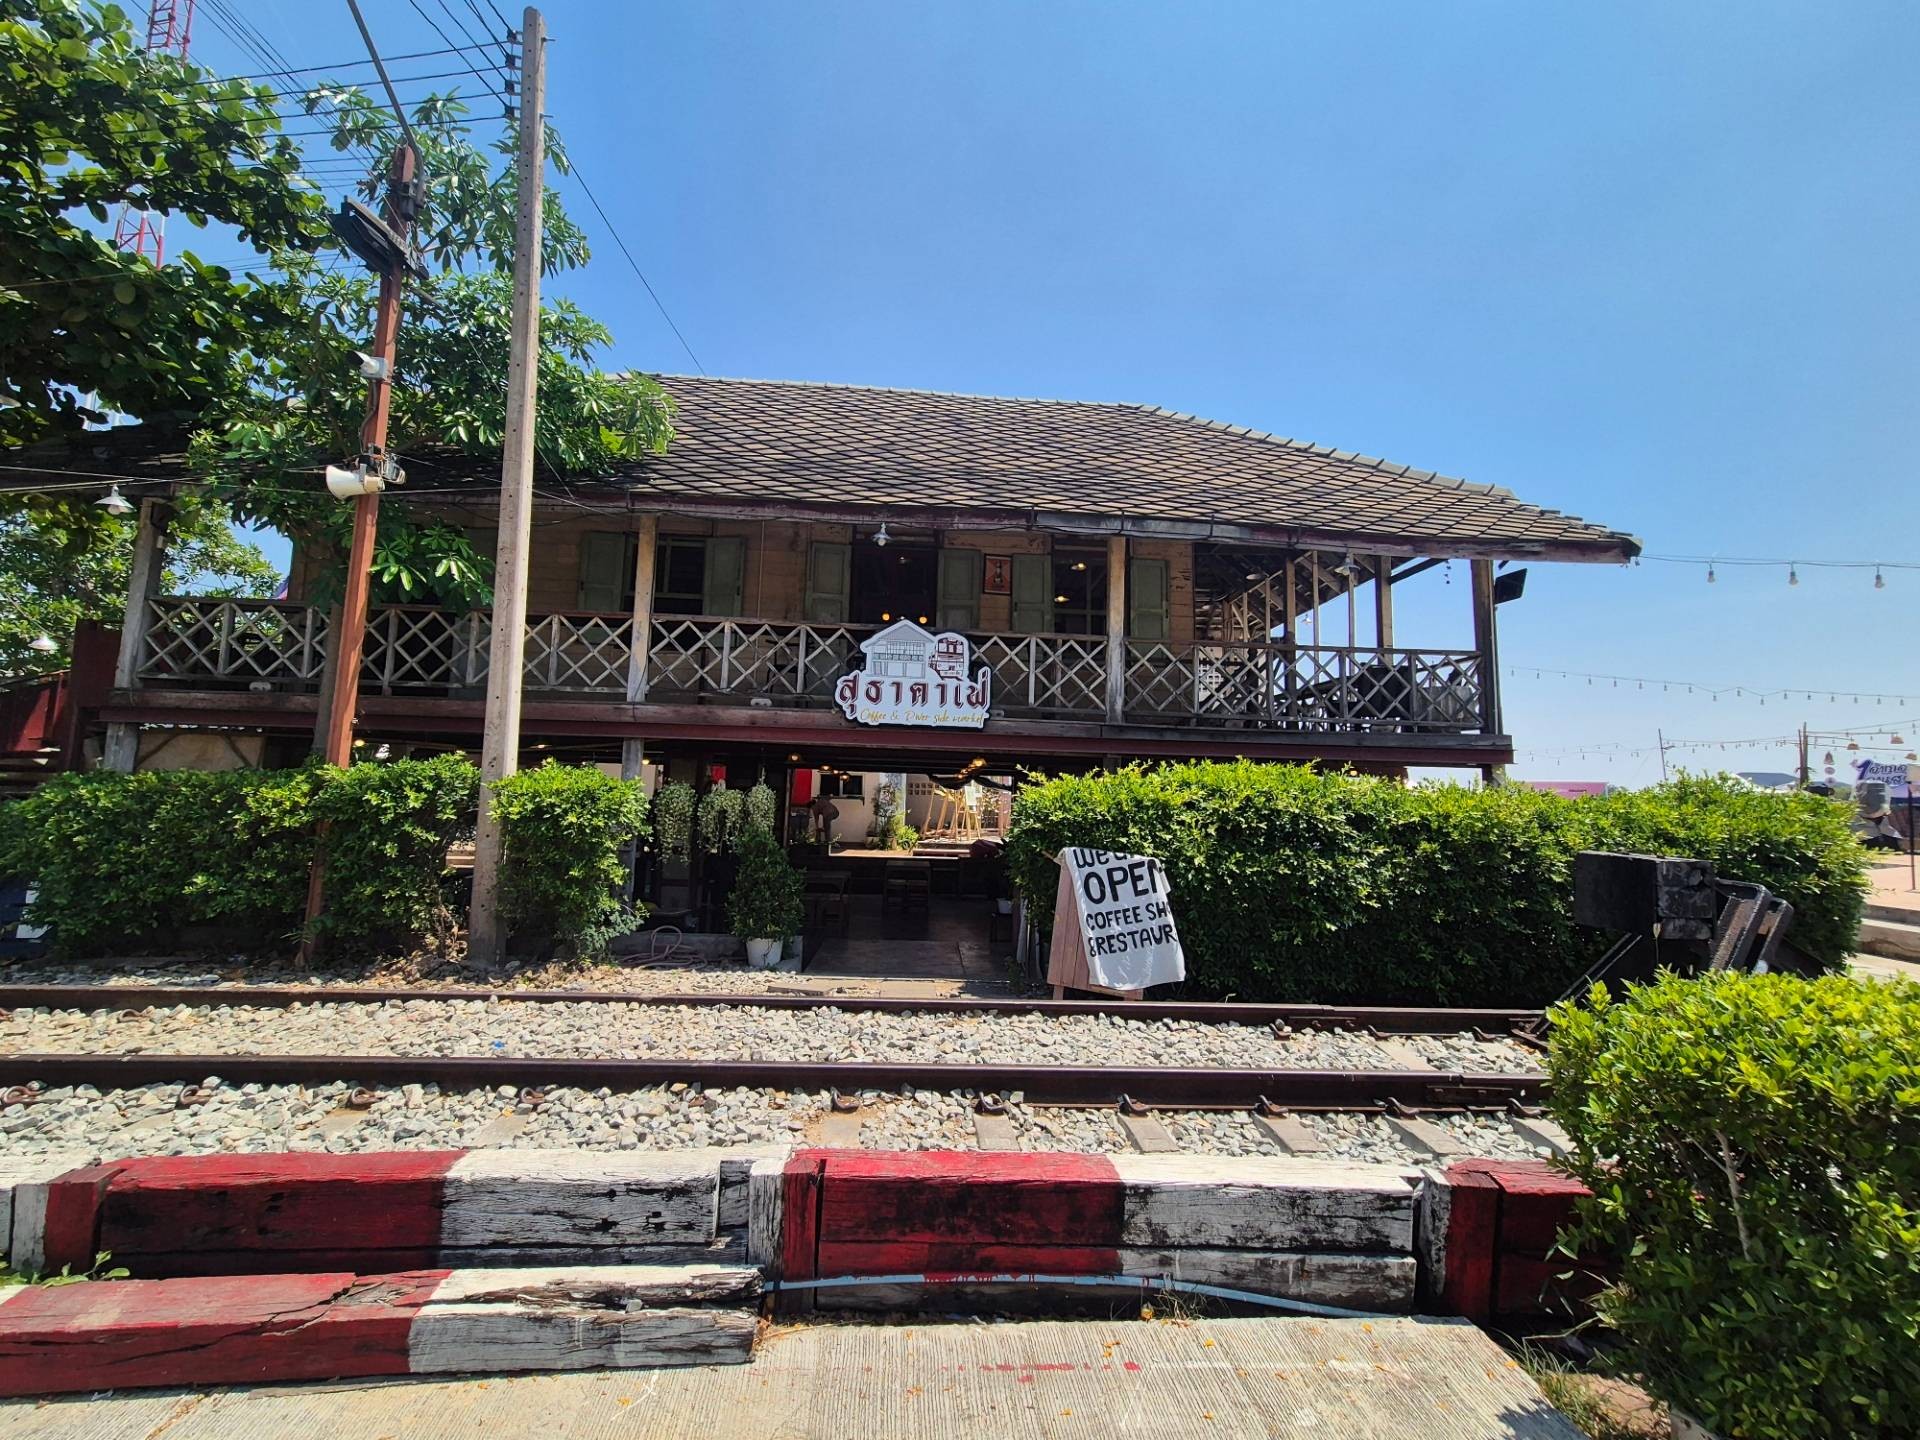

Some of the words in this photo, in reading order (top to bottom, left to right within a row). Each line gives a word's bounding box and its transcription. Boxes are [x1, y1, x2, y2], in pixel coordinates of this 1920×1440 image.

[860, 708, 887, 723] Coffee
[1086, 906, 1143, 931] COFFEE
[1145, 901, 1171, 921] SH
